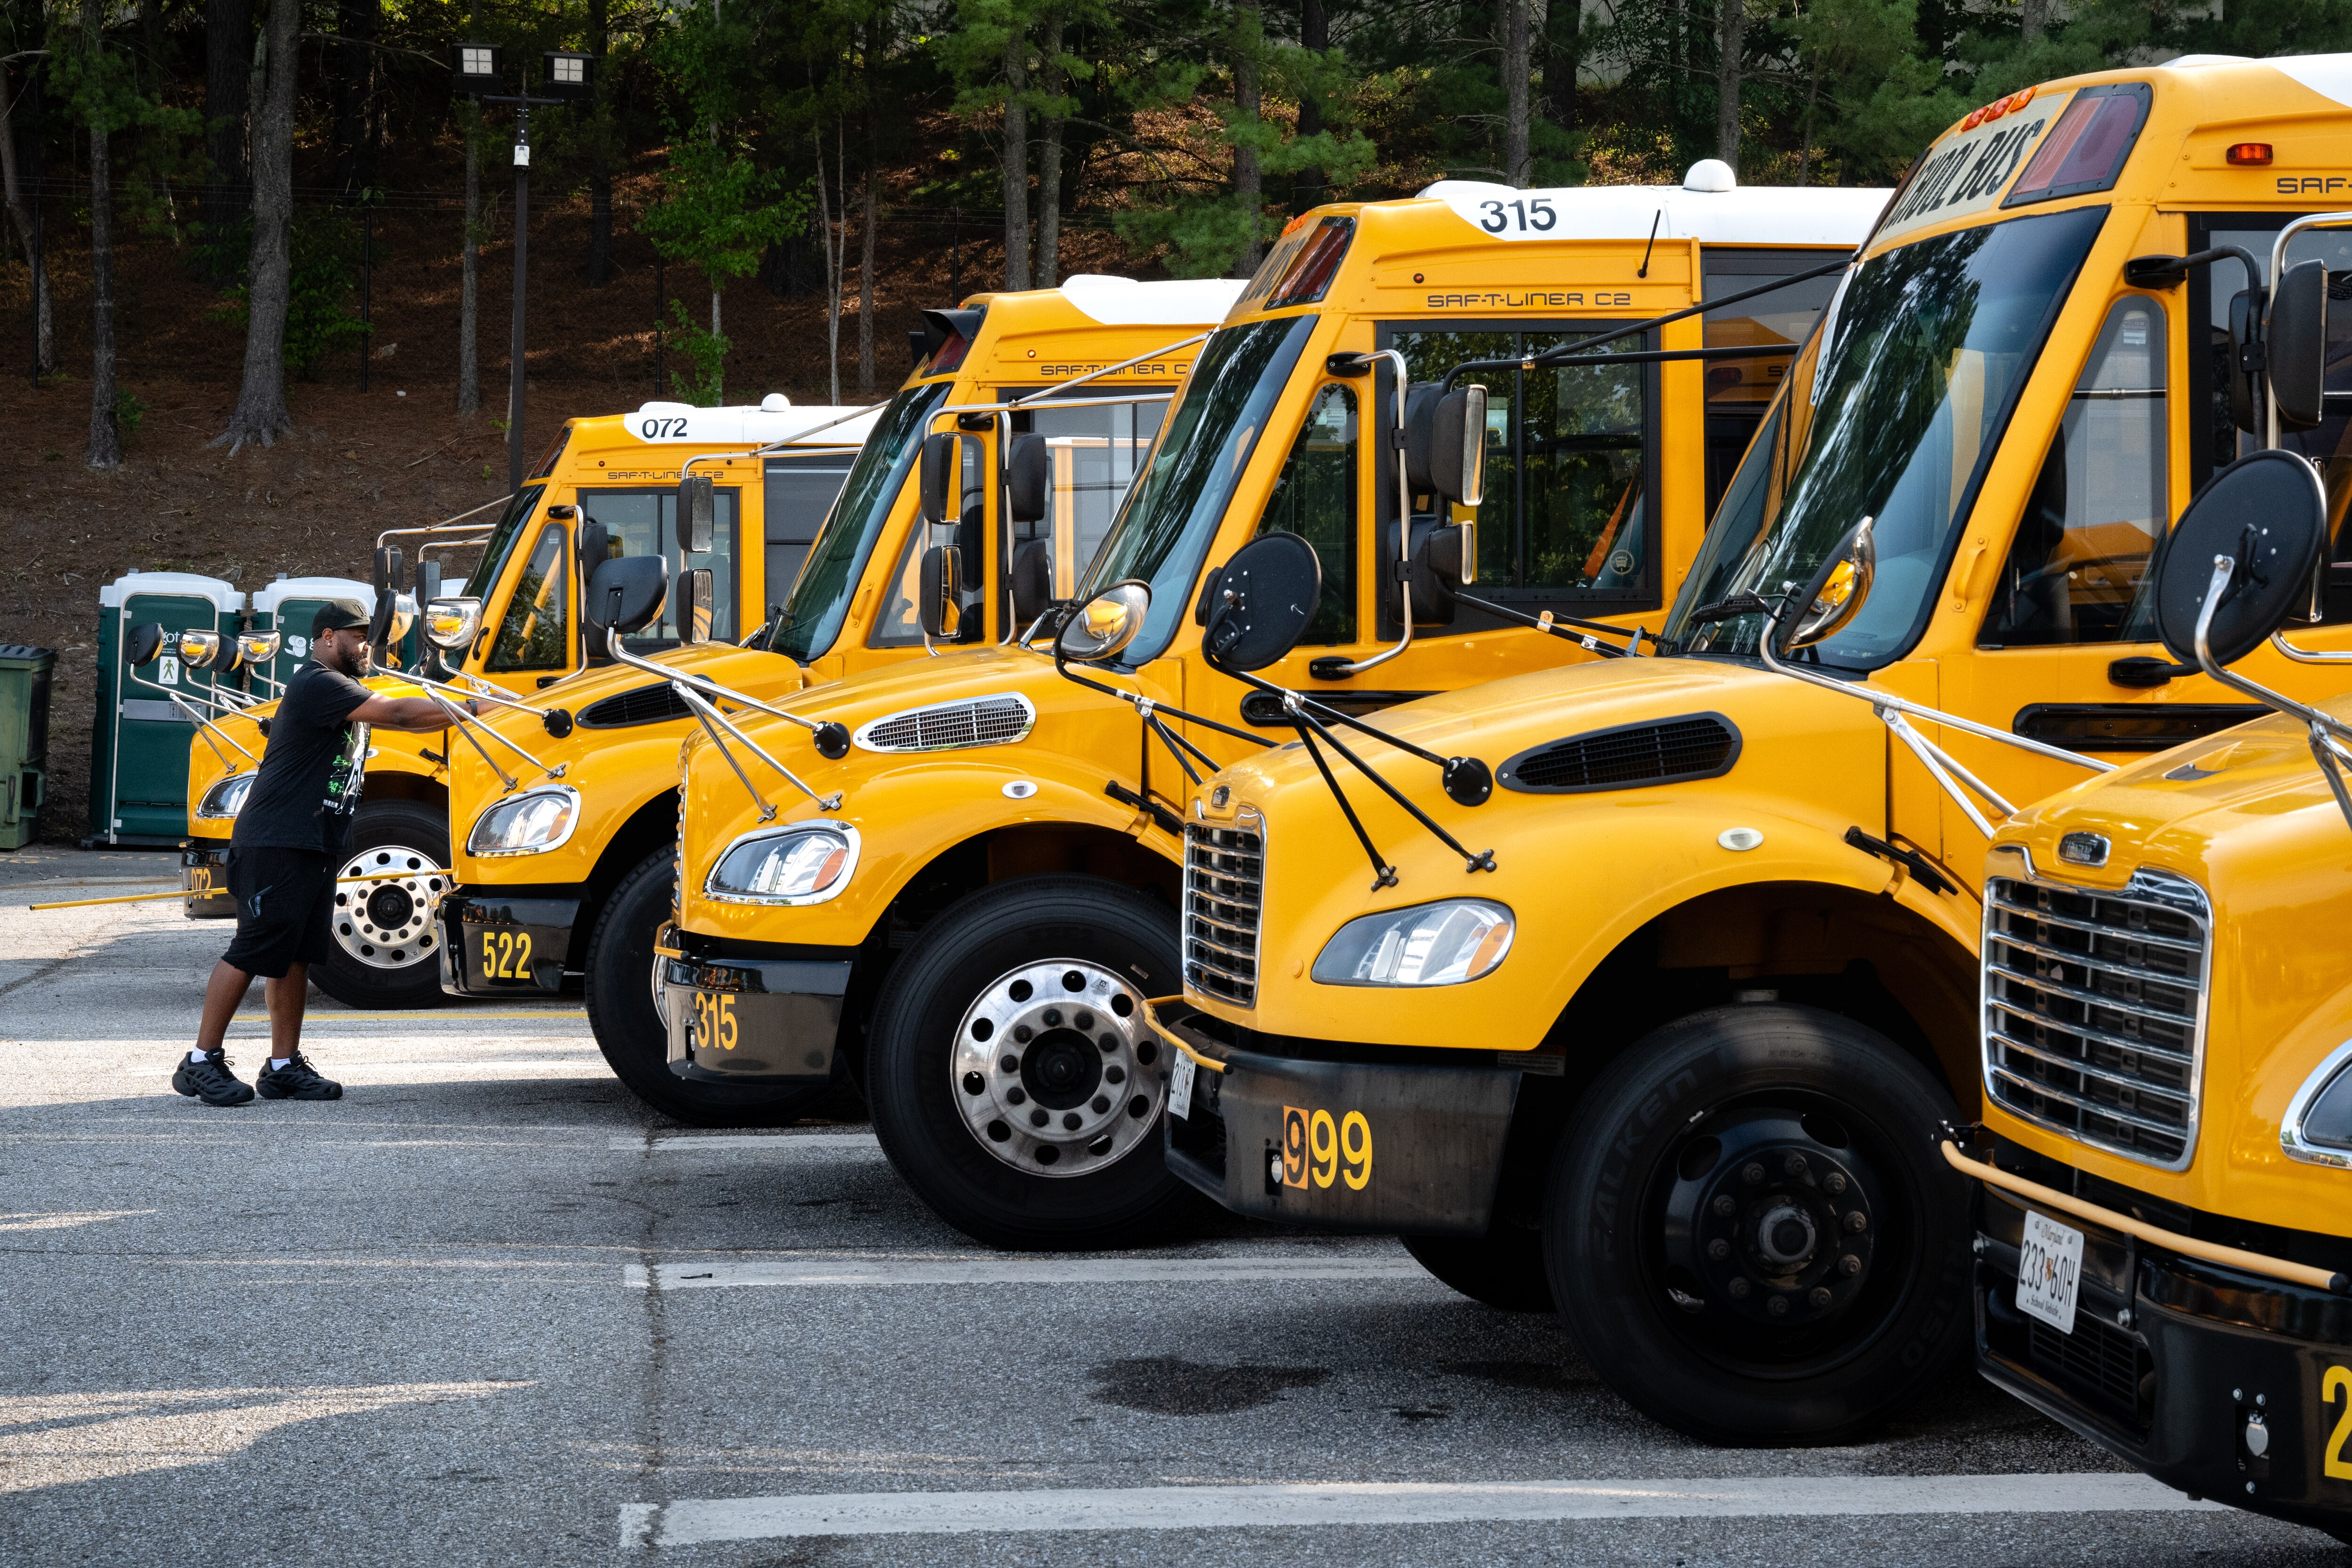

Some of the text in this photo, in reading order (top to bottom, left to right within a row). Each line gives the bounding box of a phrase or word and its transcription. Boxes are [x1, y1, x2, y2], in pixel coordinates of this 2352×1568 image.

[1947, 119, 2045, 206] BUS
[1479, 198, 1557, 233] 315
[1428, 293, 1631, 307] SAF-T-LINER C2
[1174, 364, 1192, 374] C
[642, 418, 688, 438] 072
[191, 868, 213, 900] 072
[484, 932, 532, 979] 522
[696, 991, 738, 1050] 315
[1284, 1109, 1372, 1190] 999
[2020, 1239, 2075, 1307] 233 60H
[2031, 1295, 2044, 1311] School
[2322, 1365, 2352, 1481] 2
